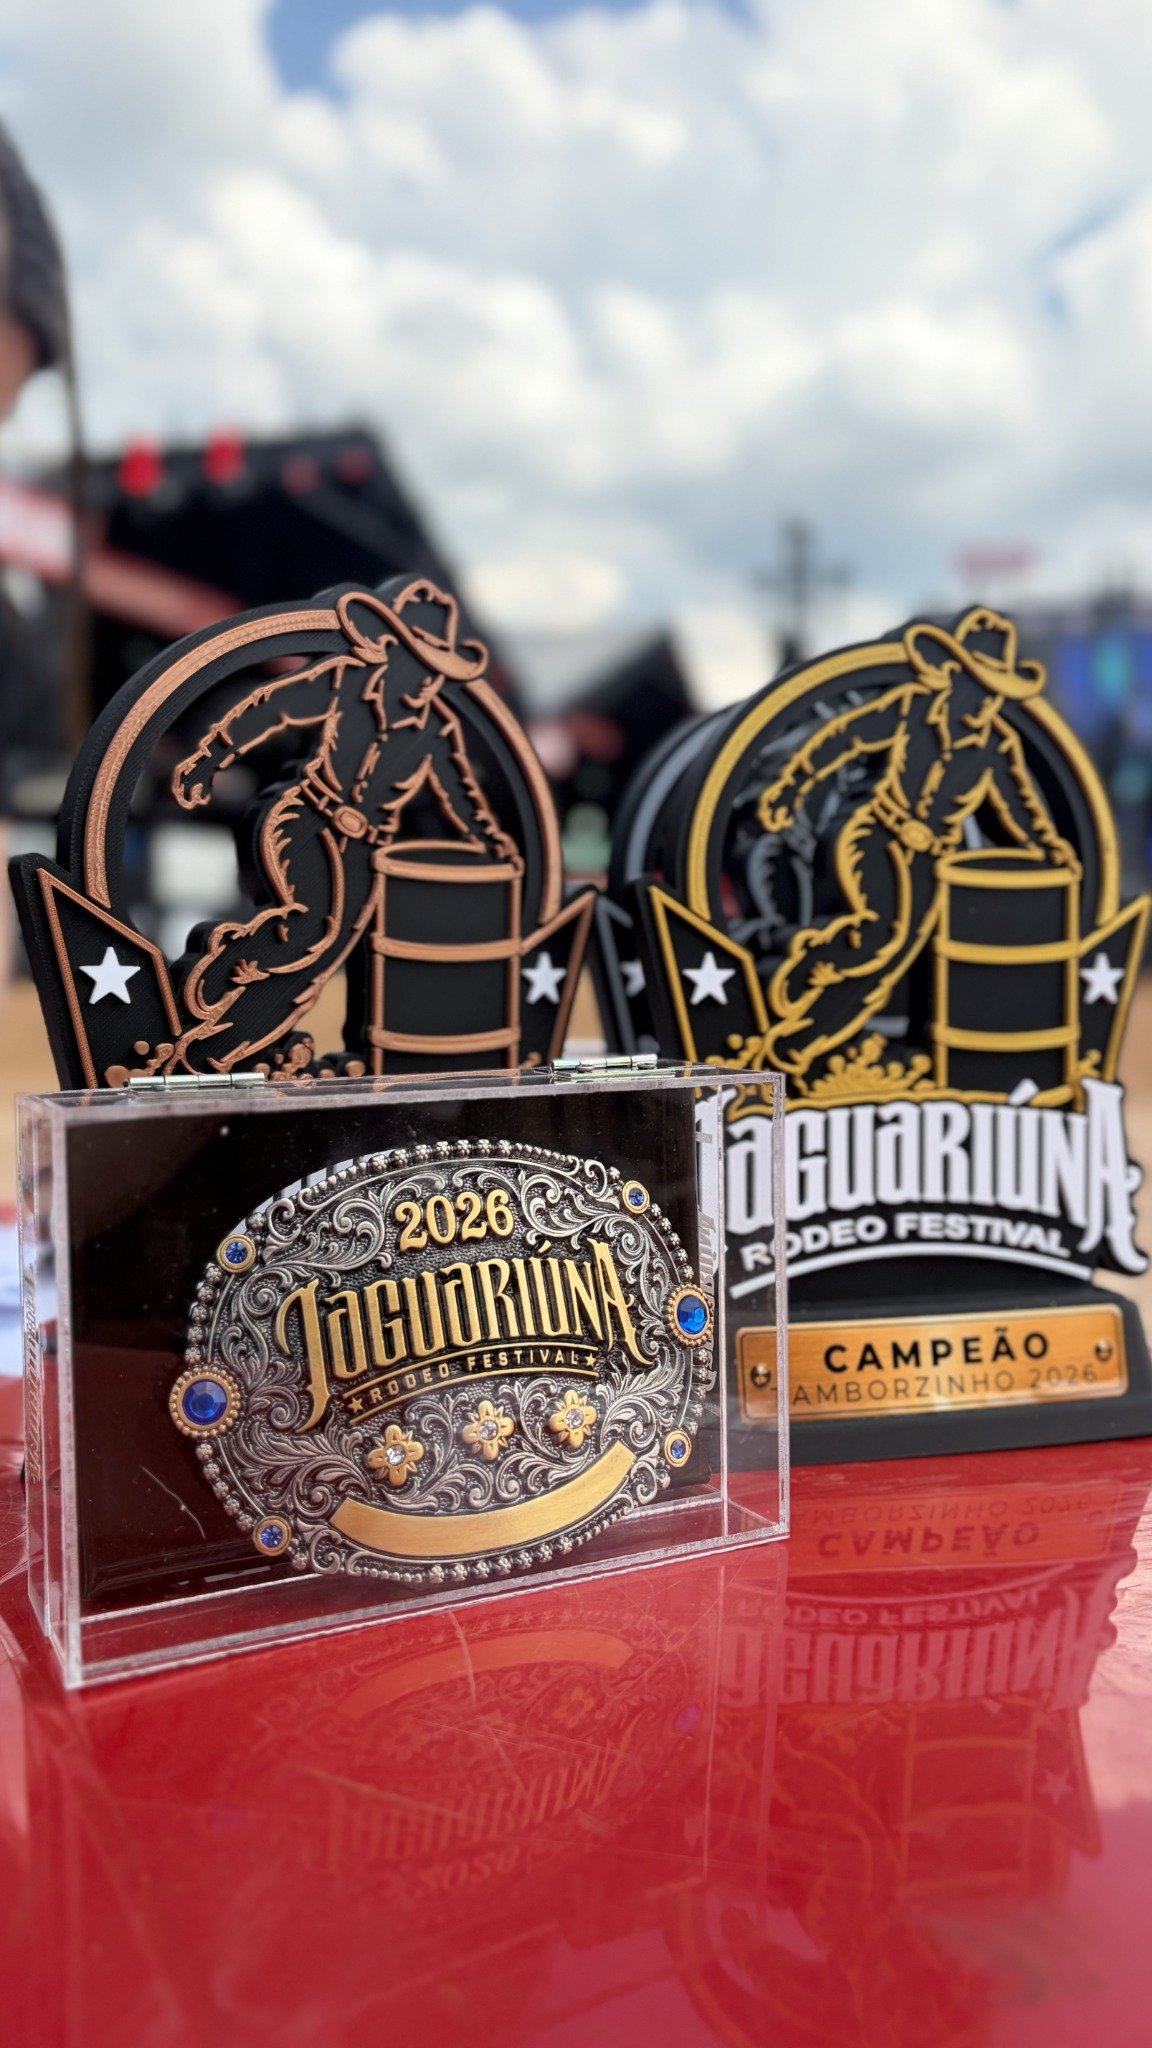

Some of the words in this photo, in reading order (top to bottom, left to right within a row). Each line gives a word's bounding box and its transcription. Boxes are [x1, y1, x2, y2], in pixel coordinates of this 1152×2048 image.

[394, 1188, 515, 1254] 2026
[740, 1214, 888, 1272] RODEO
[895, 1212, 1072, 1259] FESTIVAL
[369, 1364, 451, 1403] RODEO
[467, 1348, 578, 1373] FESTIVAL
[823, 1326, 1050, 1374] CAMPEÃO
[770, 1370, 1016, 1407] AMBORZINHO
[1029, 1362, 1099, 1391] 2026
